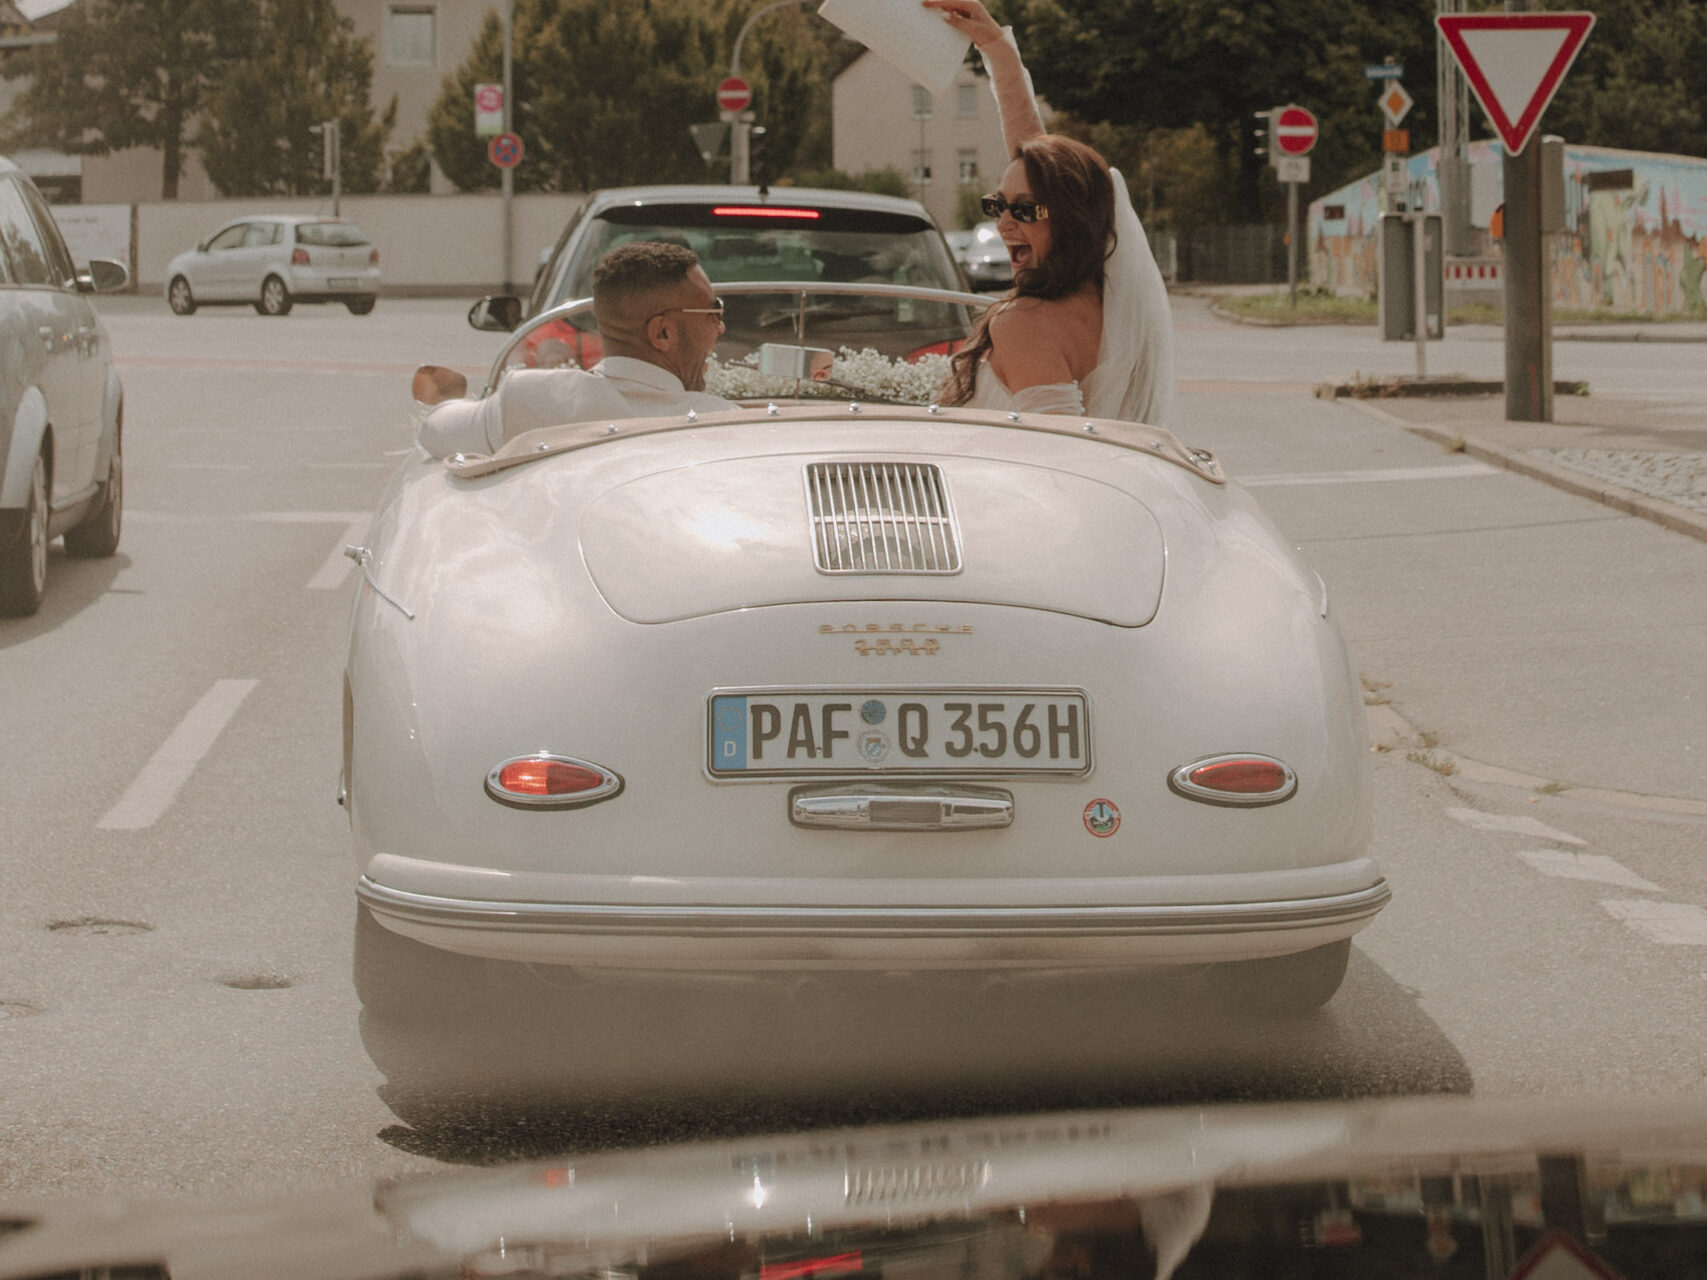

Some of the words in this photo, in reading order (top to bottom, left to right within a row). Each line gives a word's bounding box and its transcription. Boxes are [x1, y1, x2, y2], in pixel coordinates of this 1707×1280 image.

[820, 624, 973, 634] PORSCHE
[751, 703, 852, 759] PAF
[898, 703, 929, 757] Q
[944, 703, 1080, 759] 356H
[724, 741, 736, 757] D
